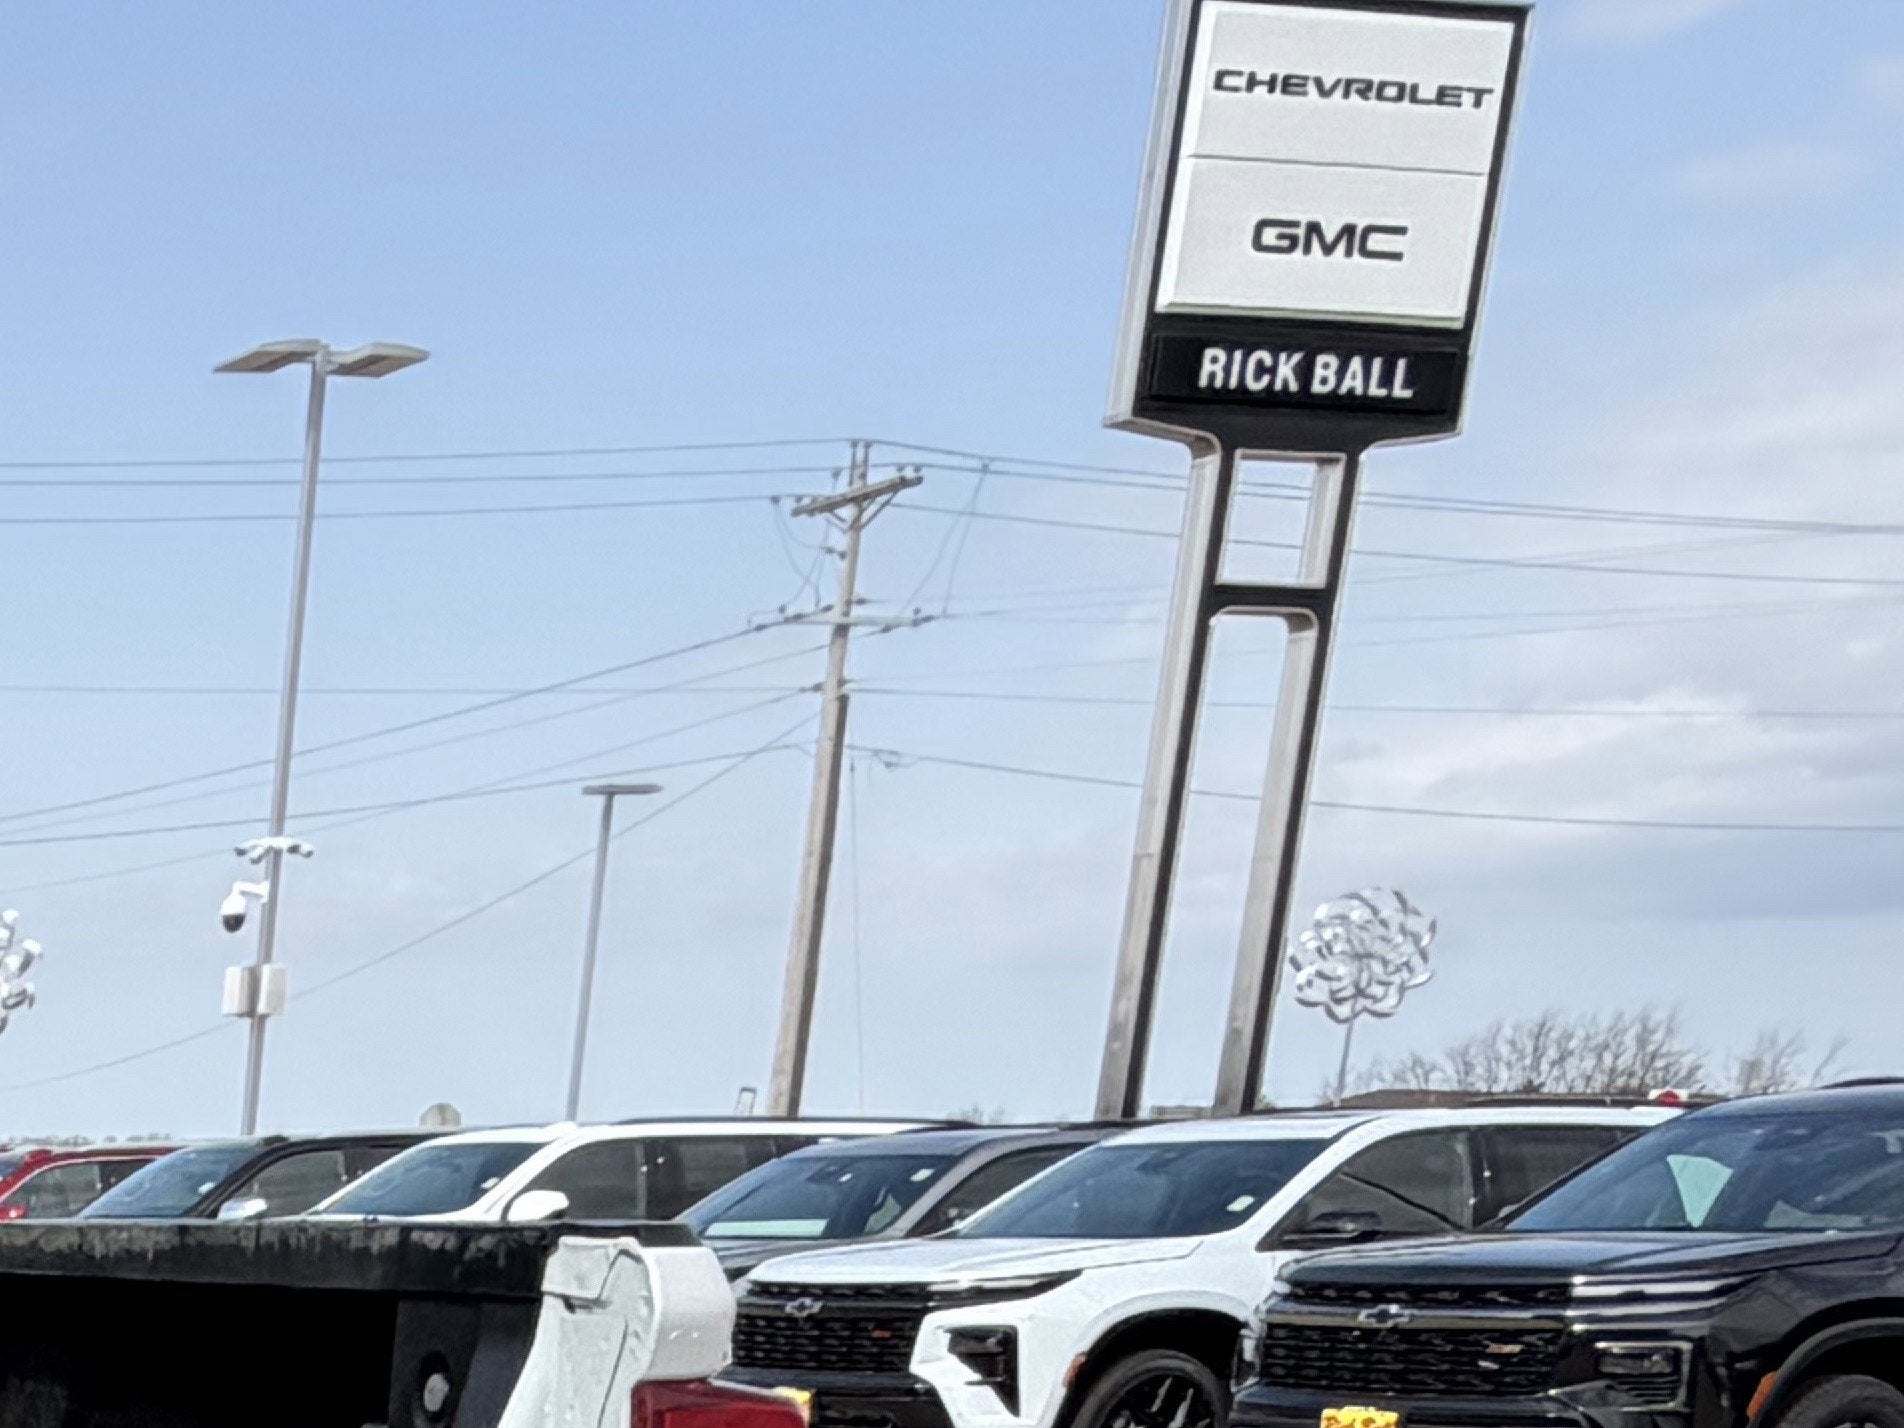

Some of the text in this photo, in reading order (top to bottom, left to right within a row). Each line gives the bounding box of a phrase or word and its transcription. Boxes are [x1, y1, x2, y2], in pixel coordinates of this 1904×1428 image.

[1212, 68, 1495, 110] CHEVROLET
[1250, 217, 1409, 262] GMC
[1197, 346, 1415, 400] RICK BALL
